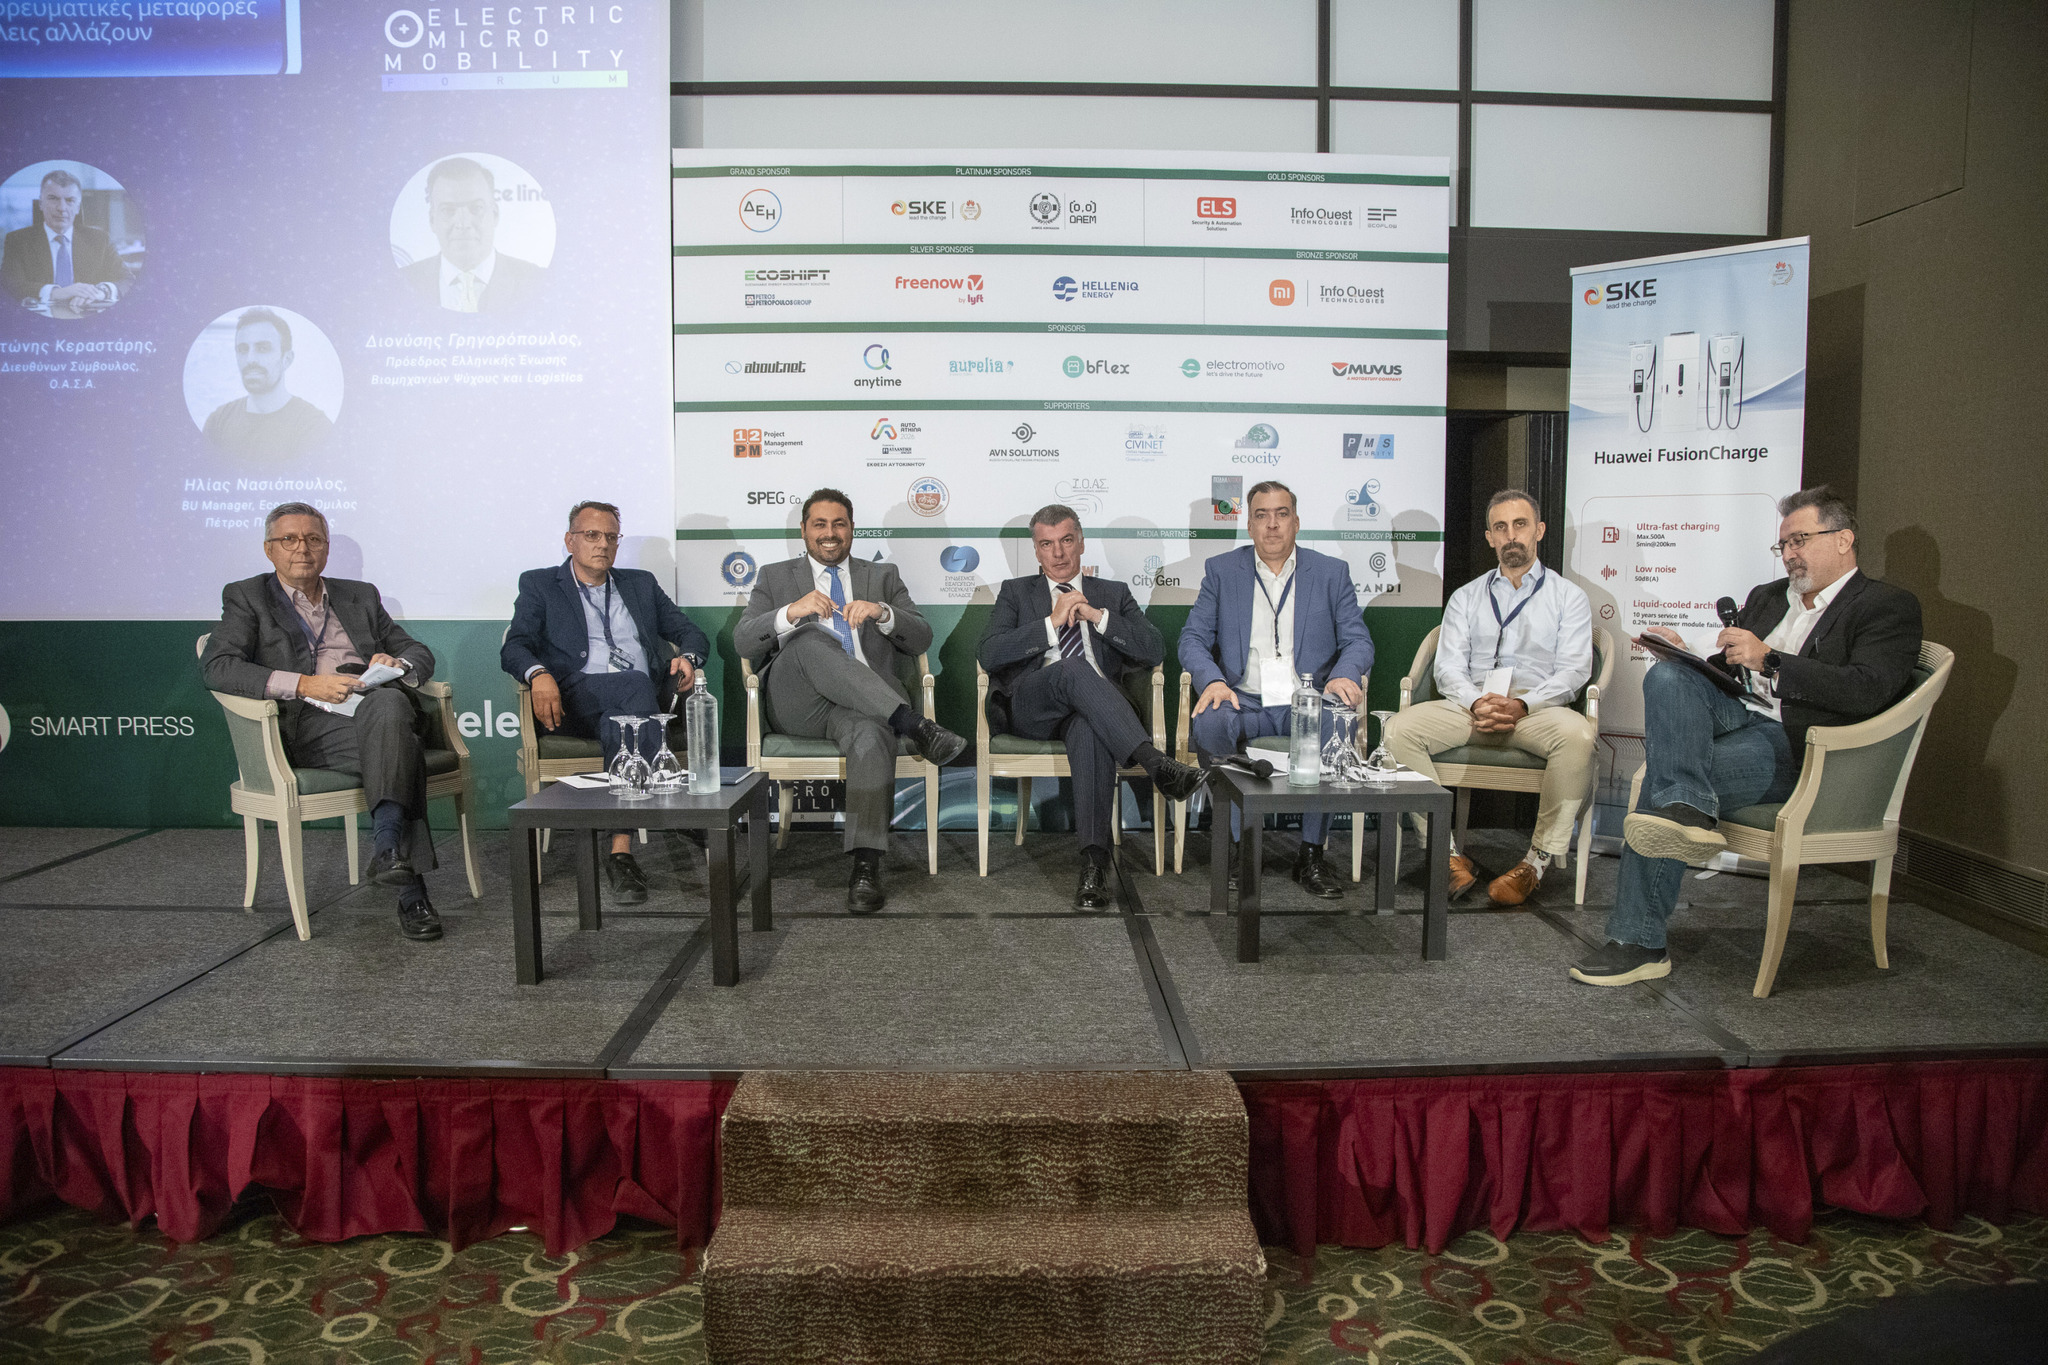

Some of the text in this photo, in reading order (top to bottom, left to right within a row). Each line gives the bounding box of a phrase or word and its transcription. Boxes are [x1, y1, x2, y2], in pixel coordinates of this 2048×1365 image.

[428, 6, 623, 27] ELECTRIC
[45, 21, 152, 45] αλλάζουν
[428, 29, 549, 49] MICRO
[384, 49, 624, 71] MOBILITY
[730, 167, 790, 176] GRAND SPONSOR
[993, 168, 1031, 176] SPONSORS
[1267, 173, 1325, 182] GOLD SPONSORS
[908, 201, 946, 215] SKE
[1200, 200, 1233, 216] ELS
[1291, 207, 1353, 220] Info Quest
[1296, 250, 1358, 260] BRONZE SPONSOR
[895, 276, 964, 289] freenow
[1320, 285, 1384, 298] Info Quest
[1606, 278, 1657, 301] SKE
[967, 294, 984, 305] lyft
[1606, 302, 1620, 310] lead
[1632, 299, 1657, 308] change
[1047, 324, 1086, 332] SPONSORS
[55, 338, 157, 355] Κεραστάρης,
[365, 332, 583, 349] Διονύσης Γρηγορόπουλος,
[1, 361, 139, 373] Διευθύνων Σύμβουλος,
[386, 356, 448, 368] Πρόεδρος
[451, 354, 515, 367] Ελληνικής
[949, 357, 1004, 373] aurelia
[1206, 360, 1285, 371] electromotivo
[1347, 364, 1402, 376] MUVUS
[371, 372, 584, 387] Βιομηχανιών Ψύχους και Logistics
[854, 376, 902, 389] anytime
[1044, 402, 1090, 410] SUPPORTERS
[1125, 440, 1164, 450] CIVINET
[989, 449, 1059, 457] AVN SOLUTIONS
[1232, 452, 1281, 467] ecocity
[1594, 446, 1768, 465] Huawei FusionCharge
[184, 477, 348, 493] Ηλίας Νασιόπουλος,
[747, 491, 803, 505] SPEG Co.
[182, 501, 198, 511] BU
[202, 500, 255, 513] Manager,
[205, 517, 249, 529] Πέτρος
[1636, 522, 1720, 532] Ultra-fast charging
[1340, 532, 1416, 540] TECHNOLOGY PARTNER
[1635, 565, 1677, 573] Low noise
[1132, 574, 1180, 589] CityGen
[1633, 599, 1691, 611] Liquid-cooled
[30, 716, 195, 737] SMART PRESS
